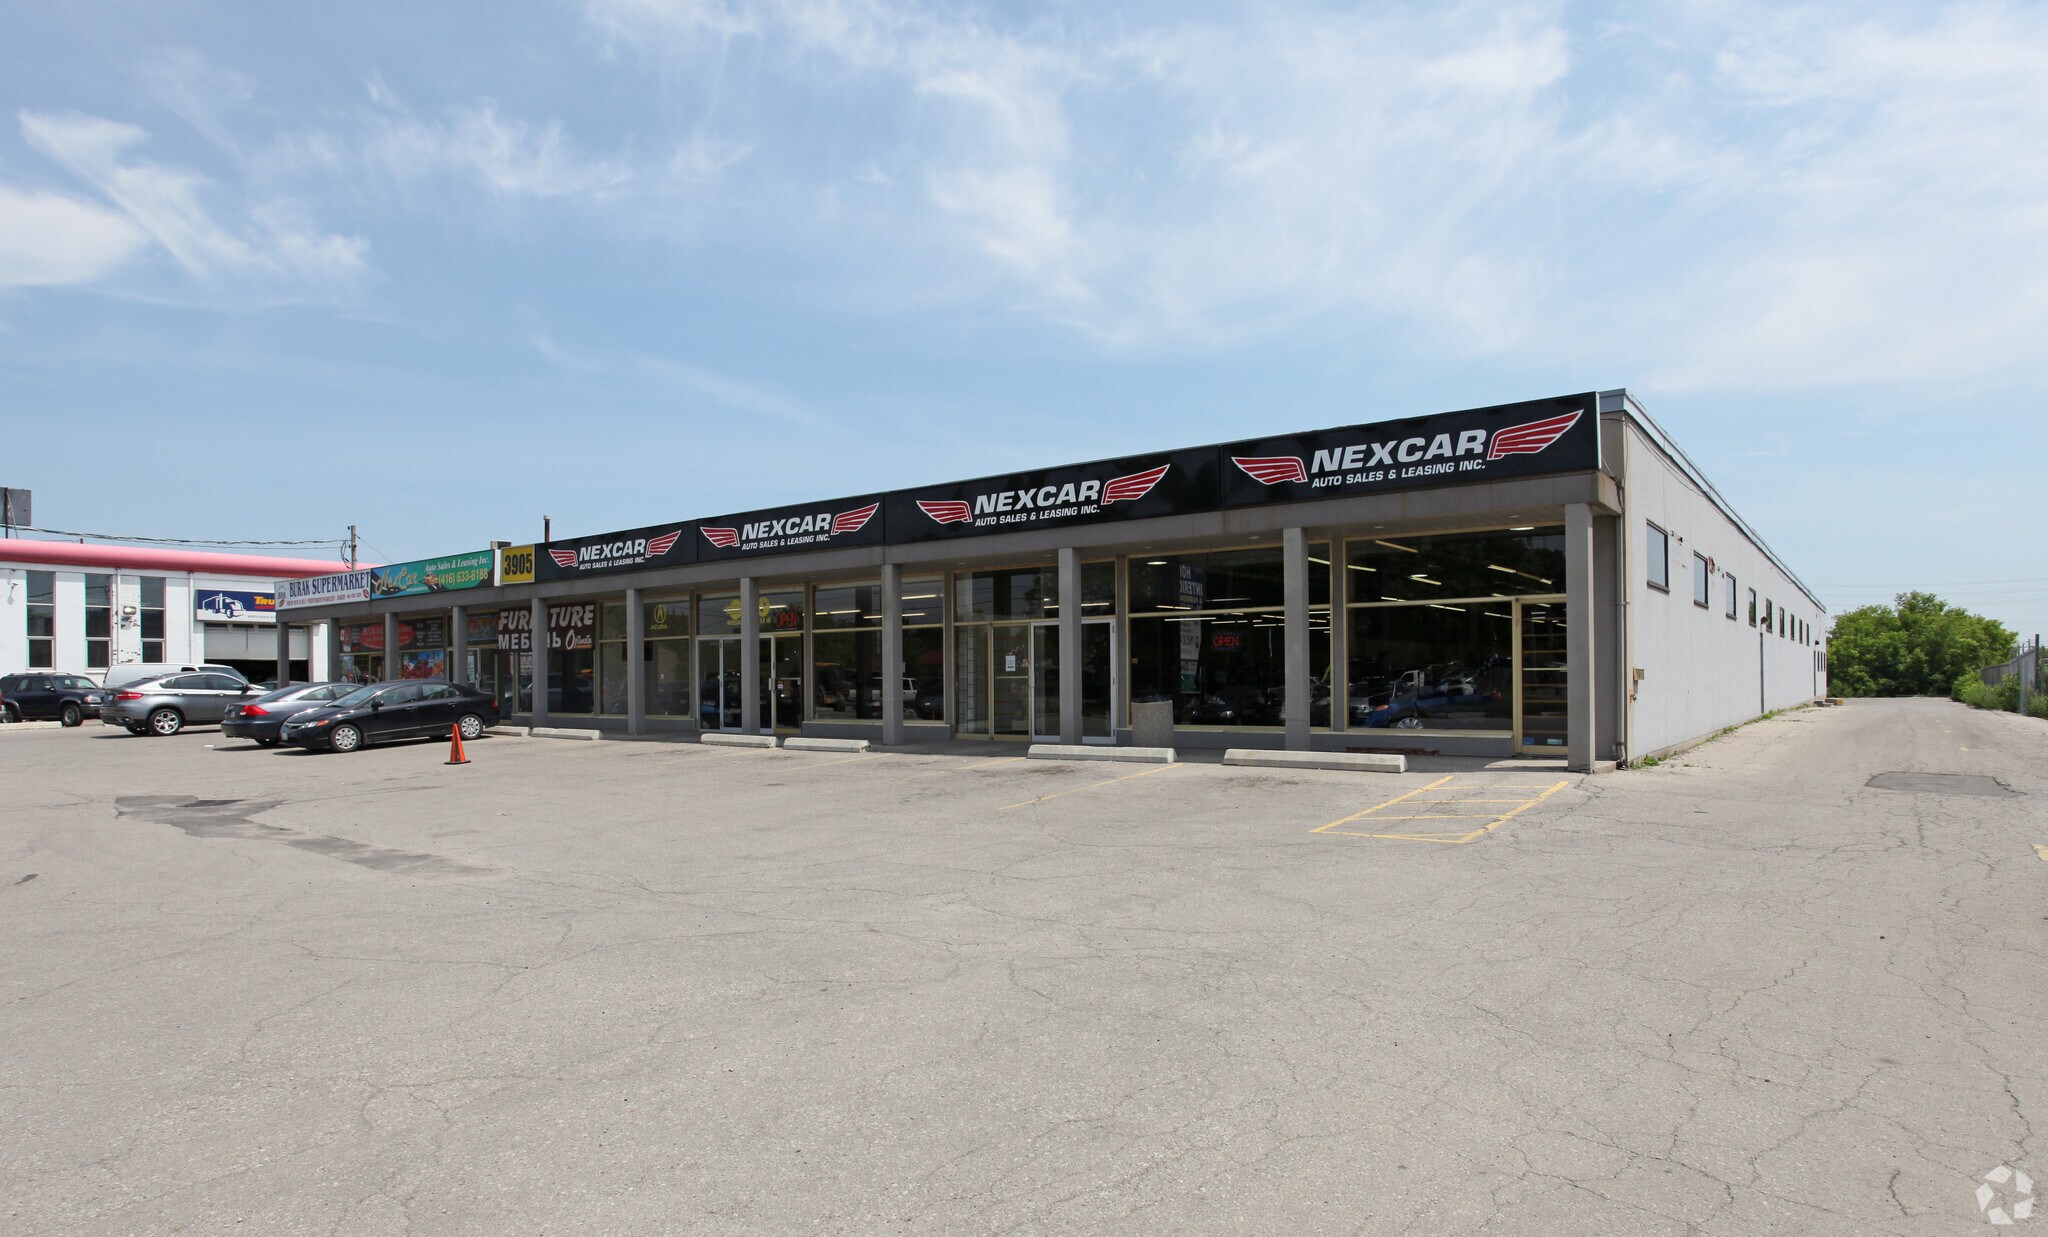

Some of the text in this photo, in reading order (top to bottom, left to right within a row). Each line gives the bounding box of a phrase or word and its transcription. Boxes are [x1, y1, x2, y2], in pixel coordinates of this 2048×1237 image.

[1310, 429, 1487, 473] NEXCAR
[1311, 458, 1486, 489] AUTO SALES & LEASING INC.
[974, 479, 1101, 515] NEXCAR
[741, 513, 832, 541] NEXCAR
[975, 504, 1100, 527] AUTO SALES & LEASING INC.
[579, 538, 647, 562] NEXCAR
[741, 533, 831, 551] AUTO SALES & LEASING INC.
[424, 555, 490, 573] Auto Sales & Leasing Inc.
[504, 553, 533, 576] 3905
[579, 562, 592, 571] AUTO
[592, 560, 608, 570] SALES
[613, 557, 634, 567] LEASING
[634, 556, 646, 565] INC.
[289, 571, 371, 598] BURAK SUPERMARKET
[438, 568, 489, 589] (416) 633-8188
[498, 604, 595, 631] FURTURE
[775, 611, 798, 628] OPEN
[498, 631, 562, 650] МЕБЬ
[1212, 635, 1240, 647] OPEN
